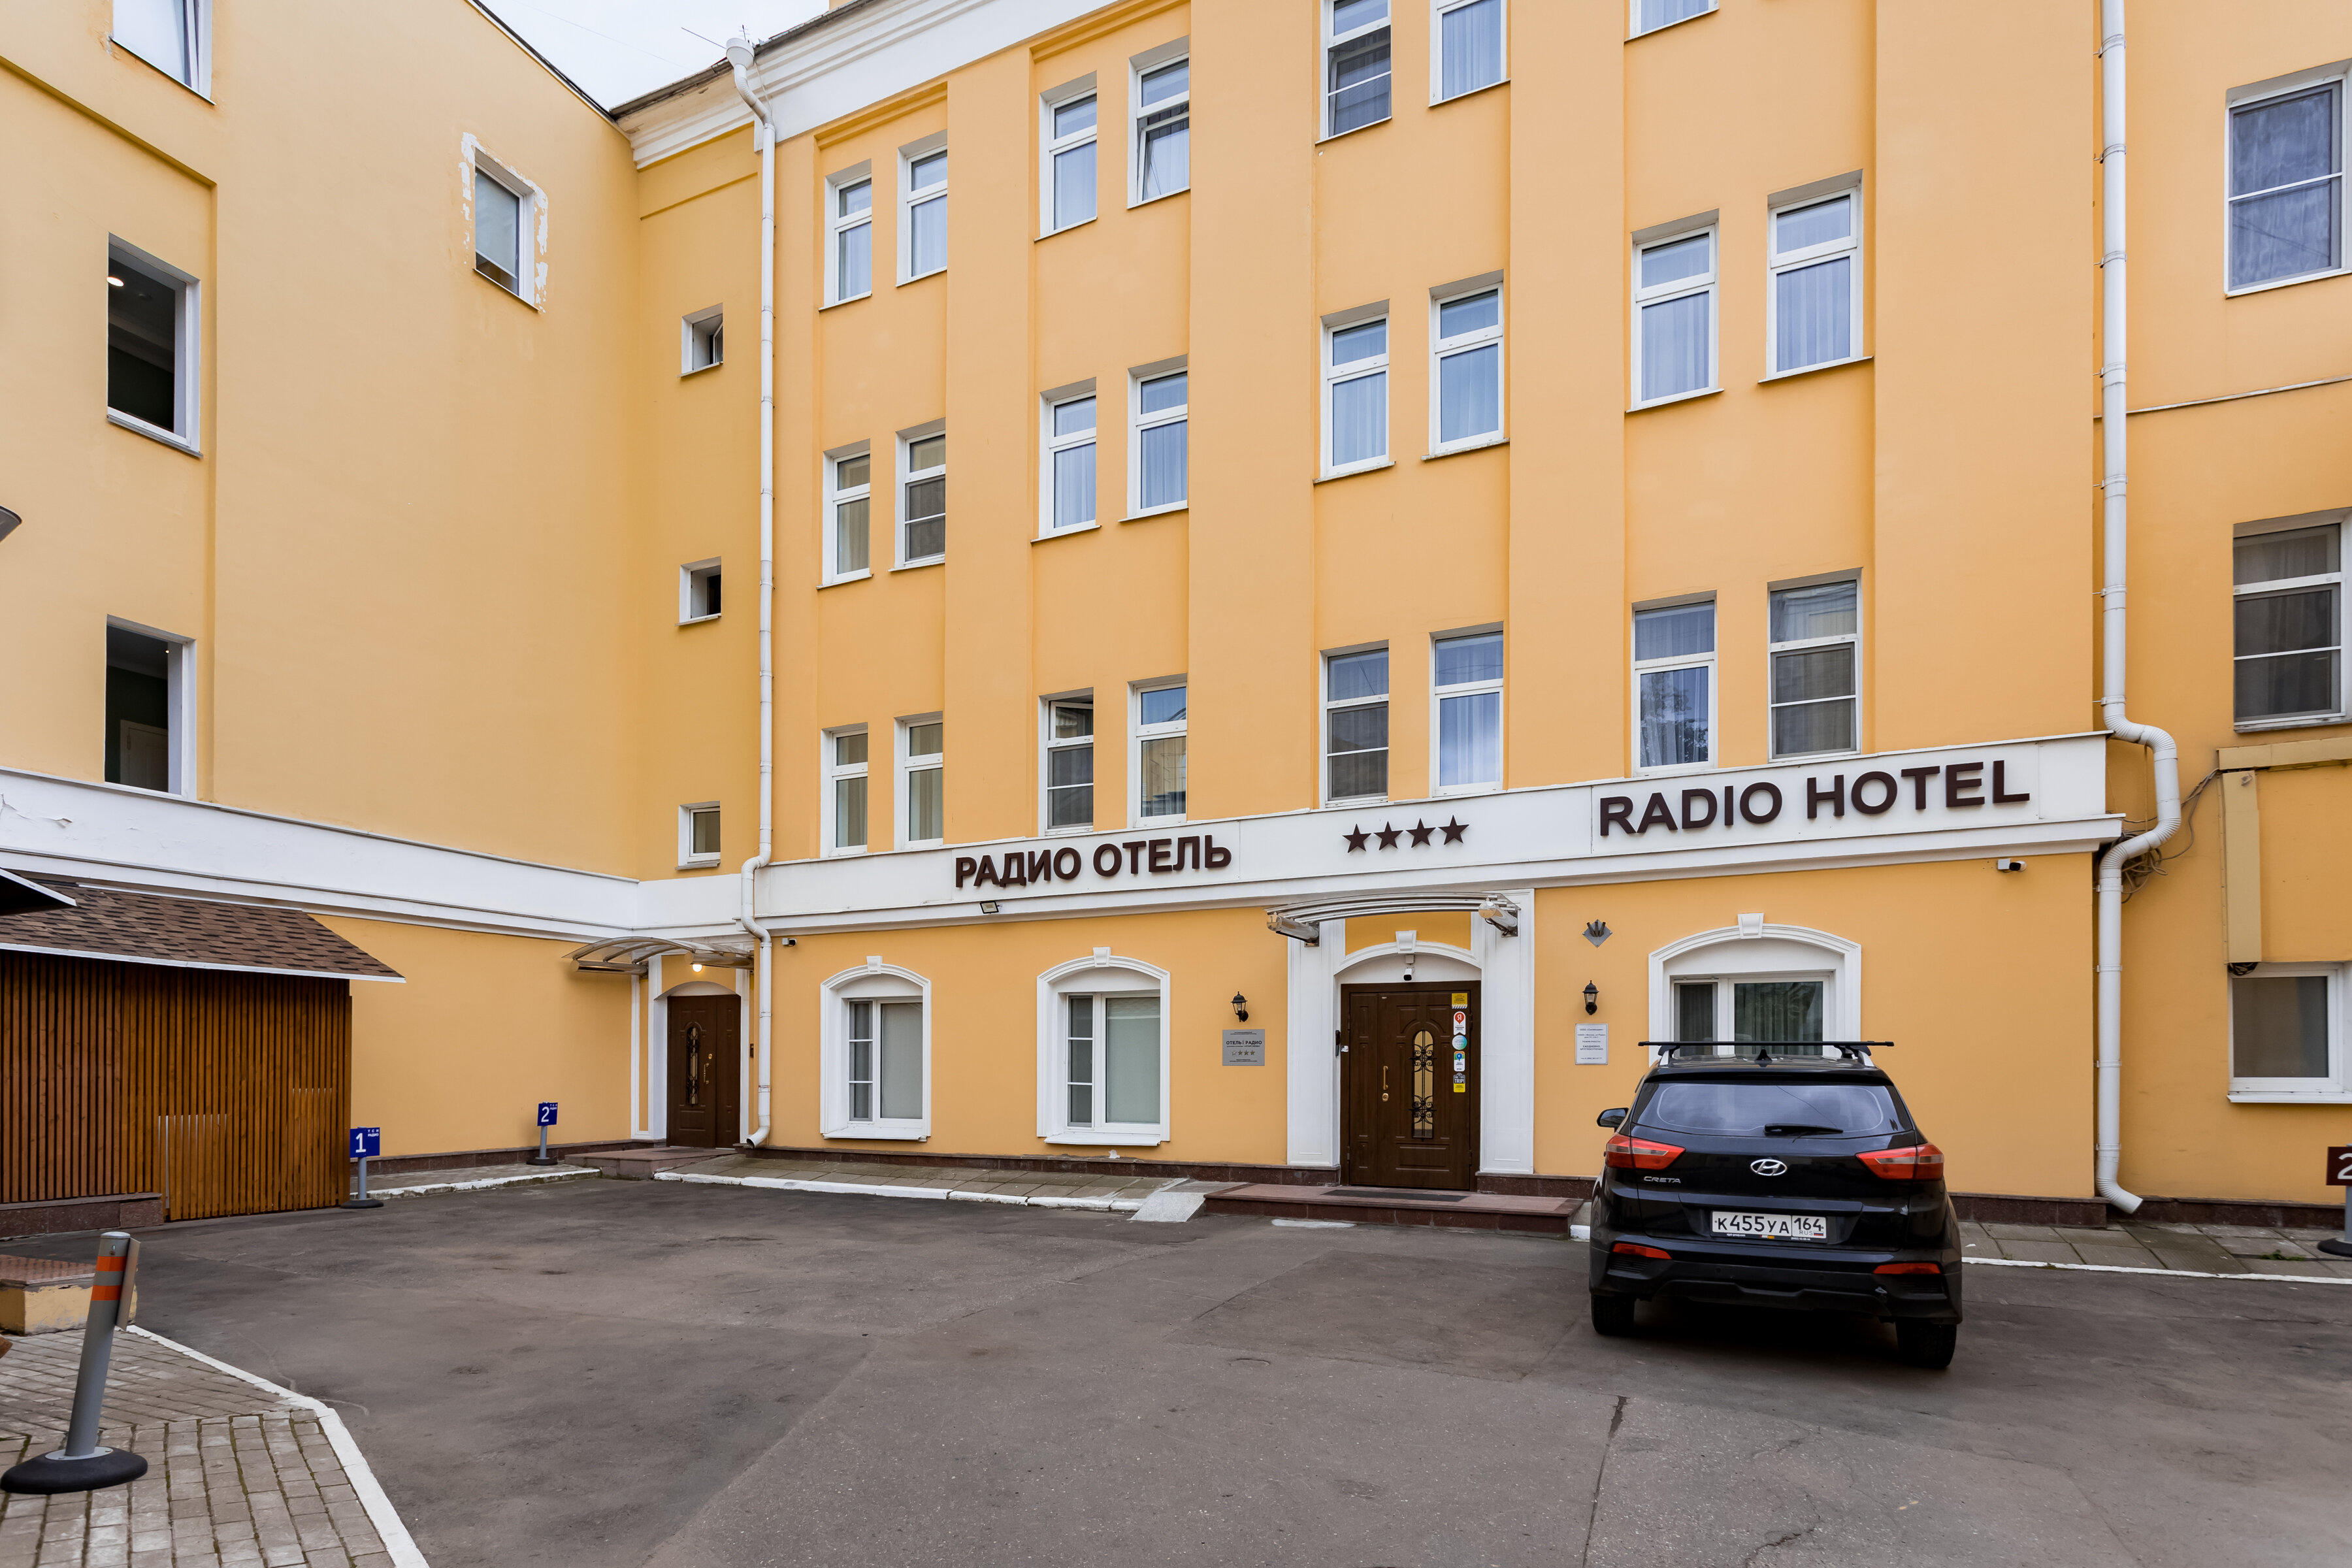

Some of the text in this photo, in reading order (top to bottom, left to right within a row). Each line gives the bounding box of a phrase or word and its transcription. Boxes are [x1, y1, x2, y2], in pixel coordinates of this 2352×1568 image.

[1599, 760, 2031, 836] RADIO HOTEL
[955, 834, 1232, 889] РАДИО ОТЕЛЬ
[541, 1106, 549, 1122] 2
[355, 1132, 367, 1153] 1
[1793, 1217, 1821, 1232] 164
